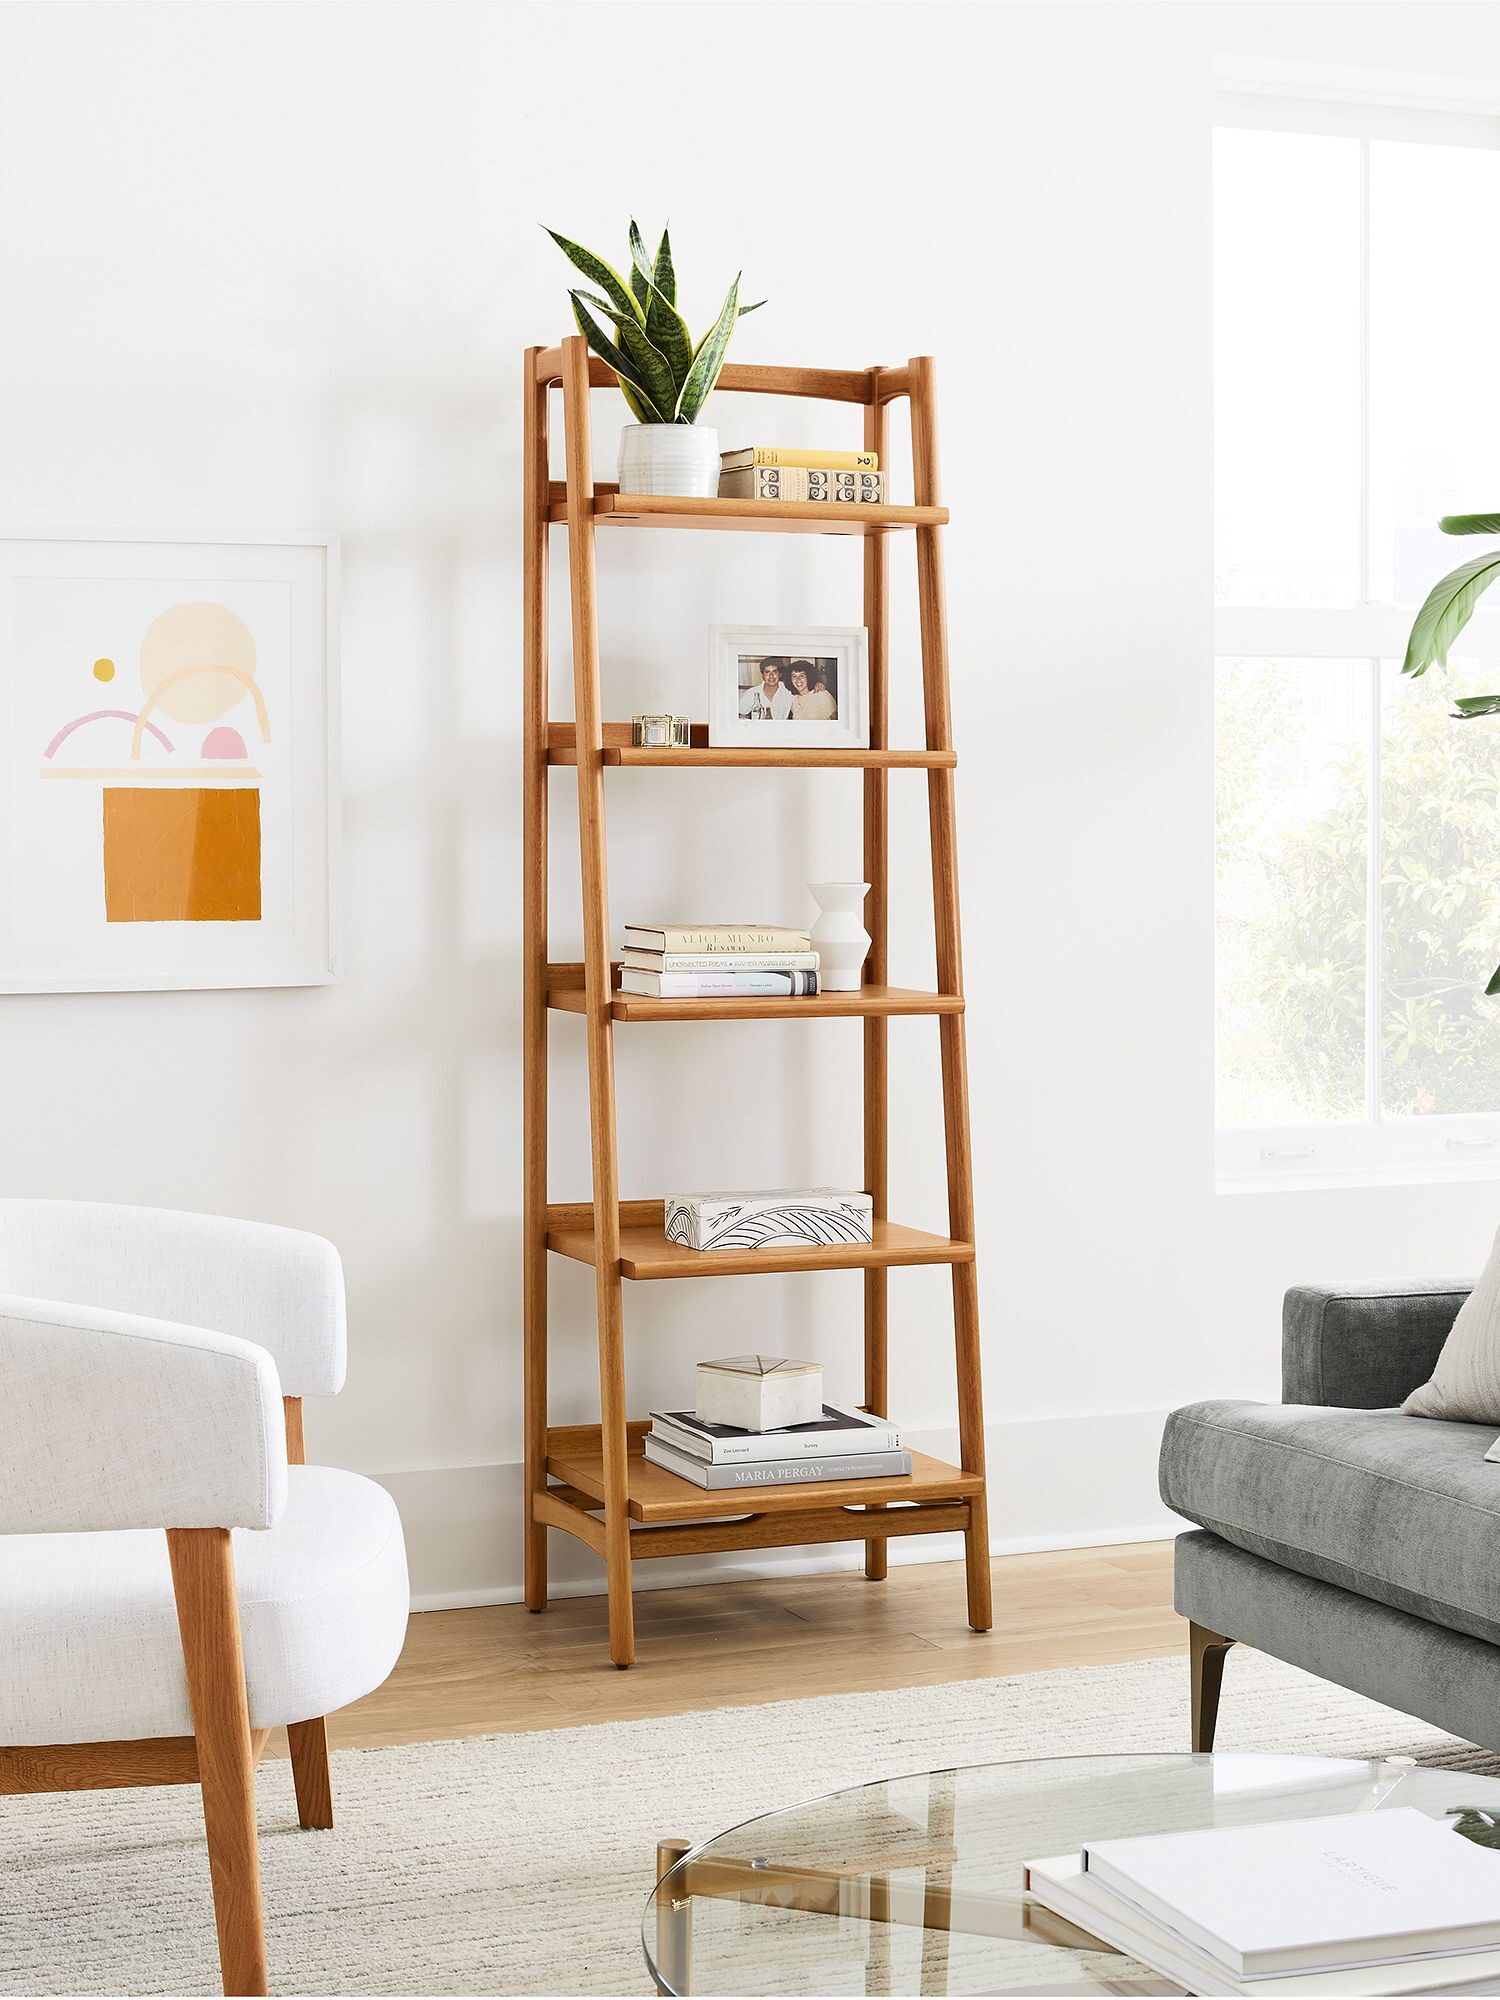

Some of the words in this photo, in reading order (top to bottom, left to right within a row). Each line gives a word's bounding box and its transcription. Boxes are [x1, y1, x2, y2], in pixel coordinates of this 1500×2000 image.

[681, 934, 720, 943] ALICE
[727, 934, 774, 943] MUNRO
[735, 1470, 775, 1482] MARIA
[778, 1466, 824, 1479] PERGAY
[1320, 1851, 1399, 1892] LARTIGUE
